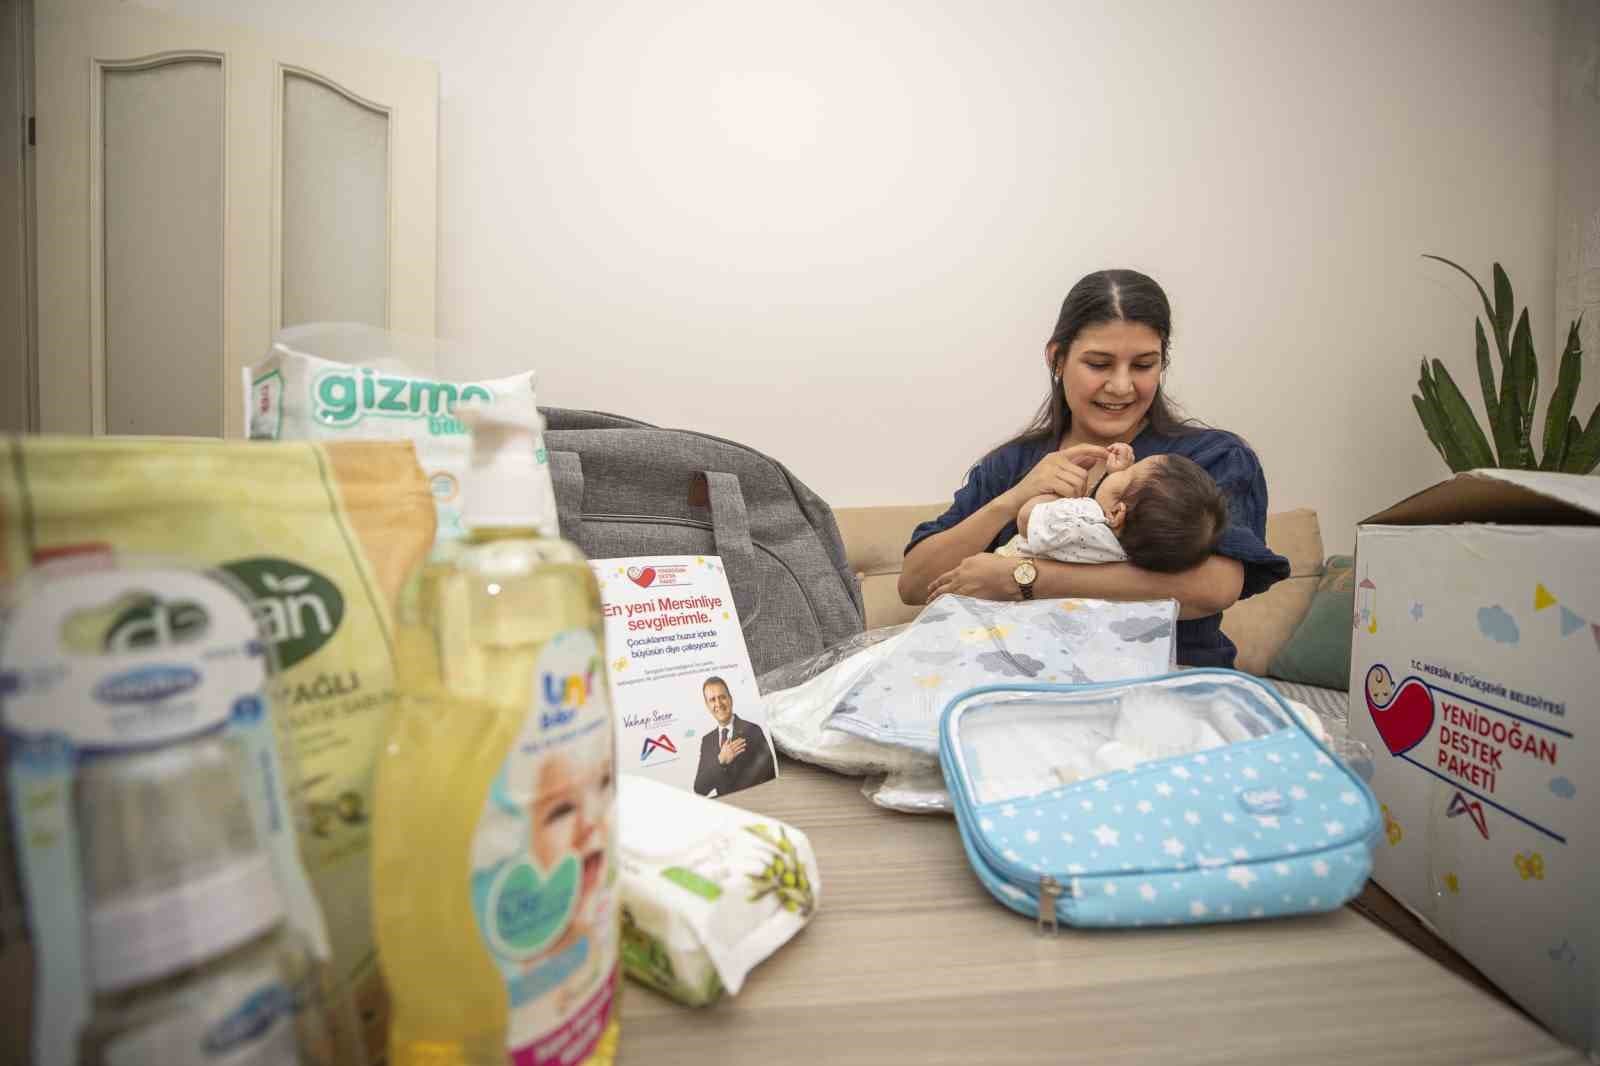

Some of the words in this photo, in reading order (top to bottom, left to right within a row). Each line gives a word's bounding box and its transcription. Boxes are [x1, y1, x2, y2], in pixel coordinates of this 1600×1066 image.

[602, 604, 622, 617] En
[625, 600, 656, 618] yeni
[658, 594, 722, 611] Mersinliye
[628, 612, 712, 631] sevgilerimle.
[1424, 663, 1451, 679] MERSİN
[1453, 672, 1507, 698] BÜYÜKŞEHİR
[1509, 689, 1566, 716] BELEDİYESİ
[1440, 726, 1503, 770] DESTEK
[1441, 702, 1557, 766] YENİDOĞAN
[1437, 750, 1496, 794] PAKETİ
